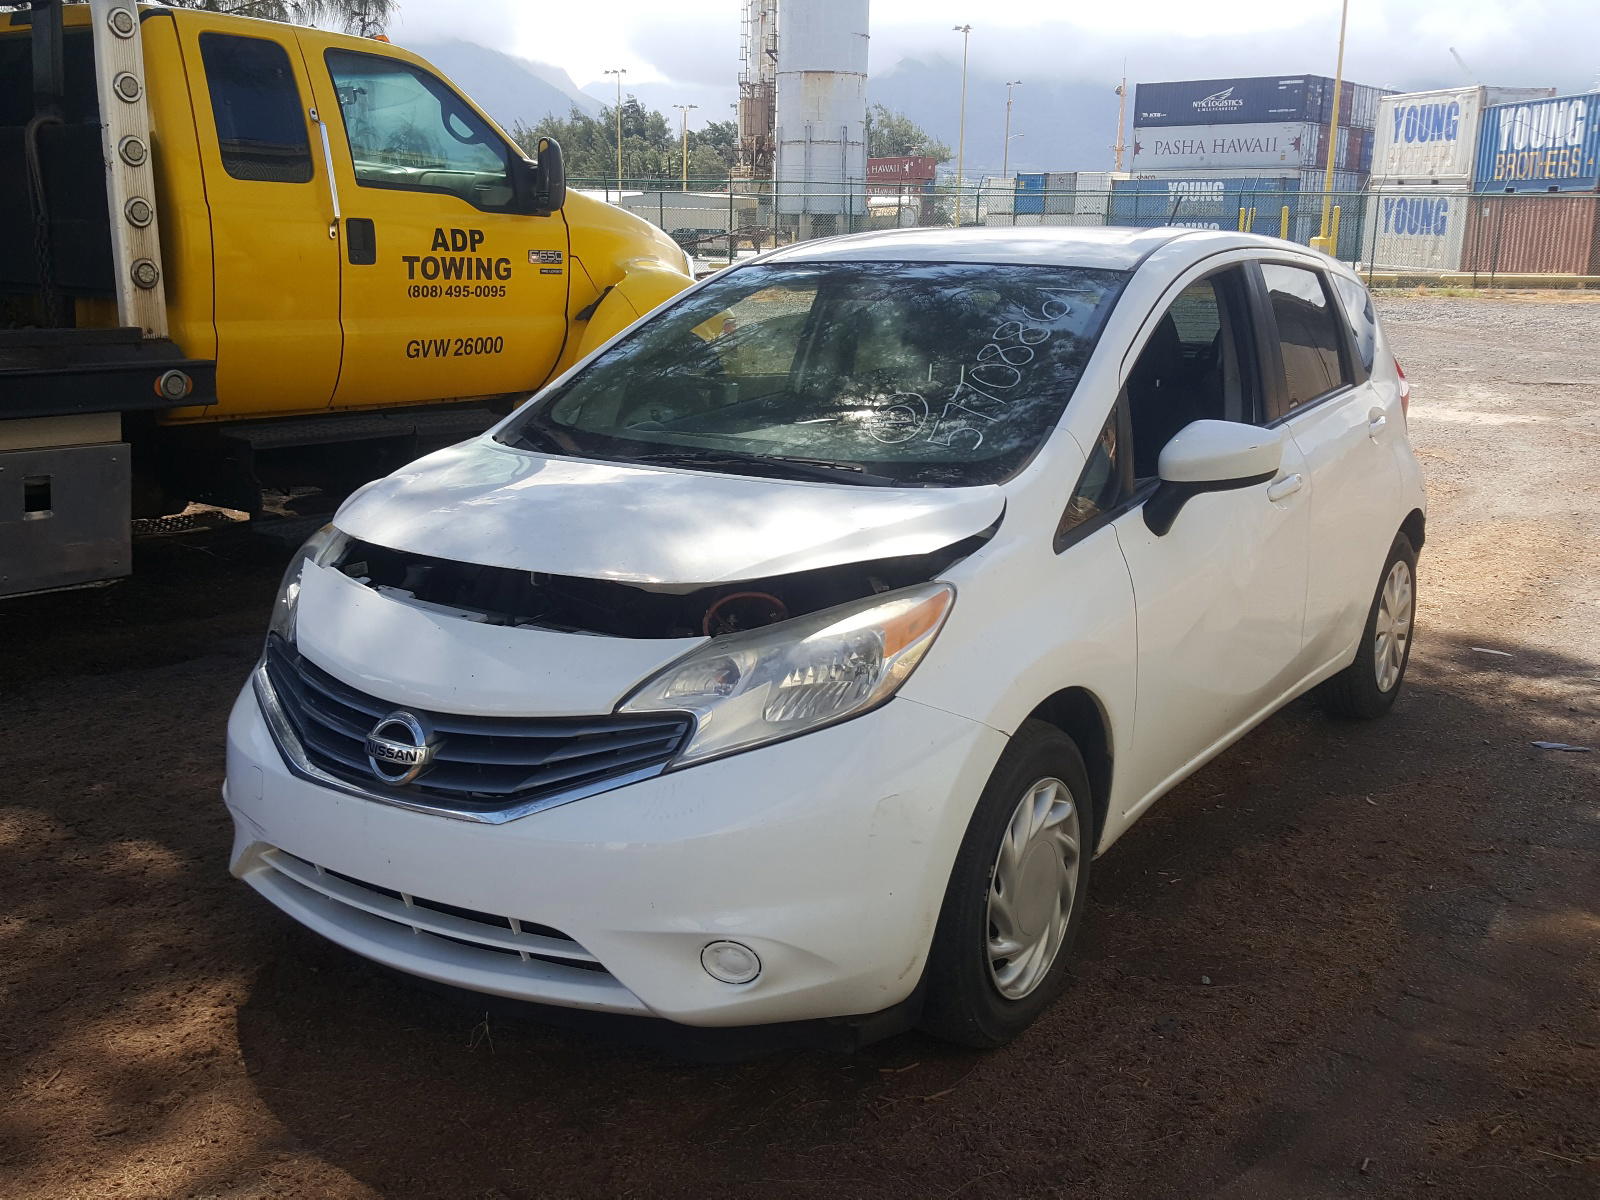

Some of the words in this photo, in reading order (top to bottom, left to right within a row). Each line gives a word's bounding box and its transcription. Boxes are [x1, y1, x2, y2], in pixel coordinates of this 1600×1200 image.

[1193, 99, 1206, 108] NYK
[1208, 99, 1243, 107] LOGISTICS
[1393, 102, 1459, 144] YOUNG
[1499, 100, 1585, 151] YOUNG
[1154, 140, 1205, 155] PASHA
[1212, 137, 1278, 153] HAWAII
[871, 164, 900, 174] HAWAII
[1495, 148, 1580, 179] BROTHERS
[1167, 181, 1225, 202] YOUNG
[1383, 197, 1448, 236] YOUNG
[431, 228, 484, 252] ADP
[402, 255, 512, 280] TOWING
[407, 285, 443, 298] (808)
[444, 285, 506, 298] 495-0095
[406, 339, 451, 358] GVW
[453, 336, 504, 356] 26000
[367, 741, 418, 762] NISSAN
